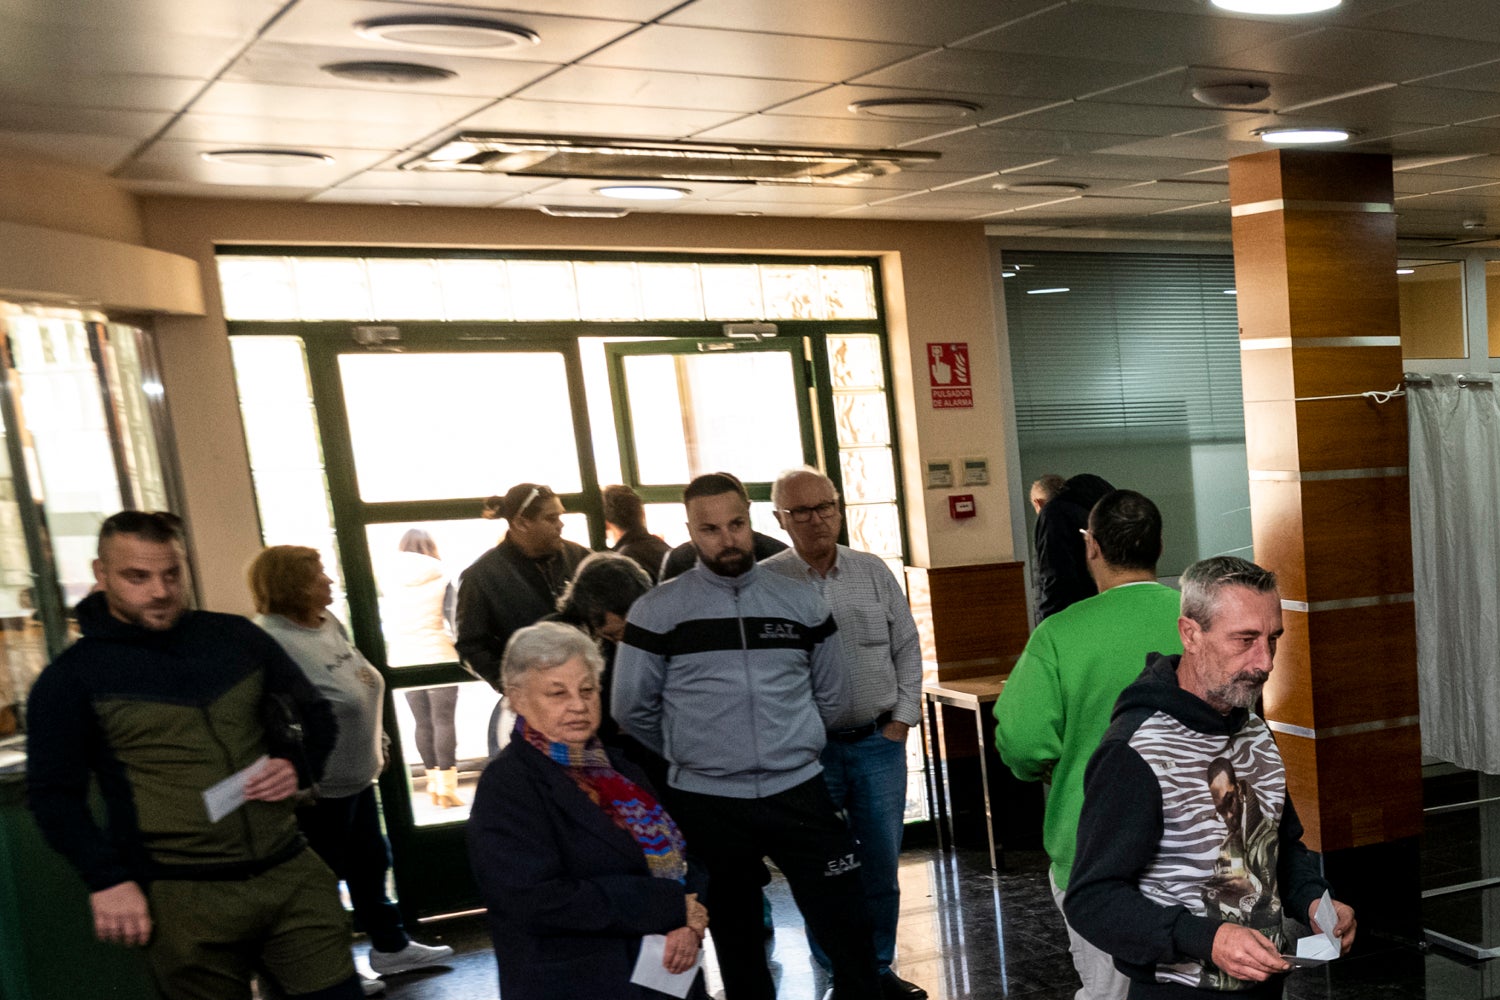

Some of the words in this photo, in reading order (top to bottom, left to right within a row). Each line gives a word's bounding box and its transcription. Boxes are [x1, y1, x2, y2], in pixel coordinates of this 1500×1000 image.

[932, 390, 971, 398] PULSADOR
[933, 399, 943, 407] DE
[944, 399, 973, 407] ALARMA
[763, 623, 794, 634] EA7
[827, 853, 855, 872] EA7
